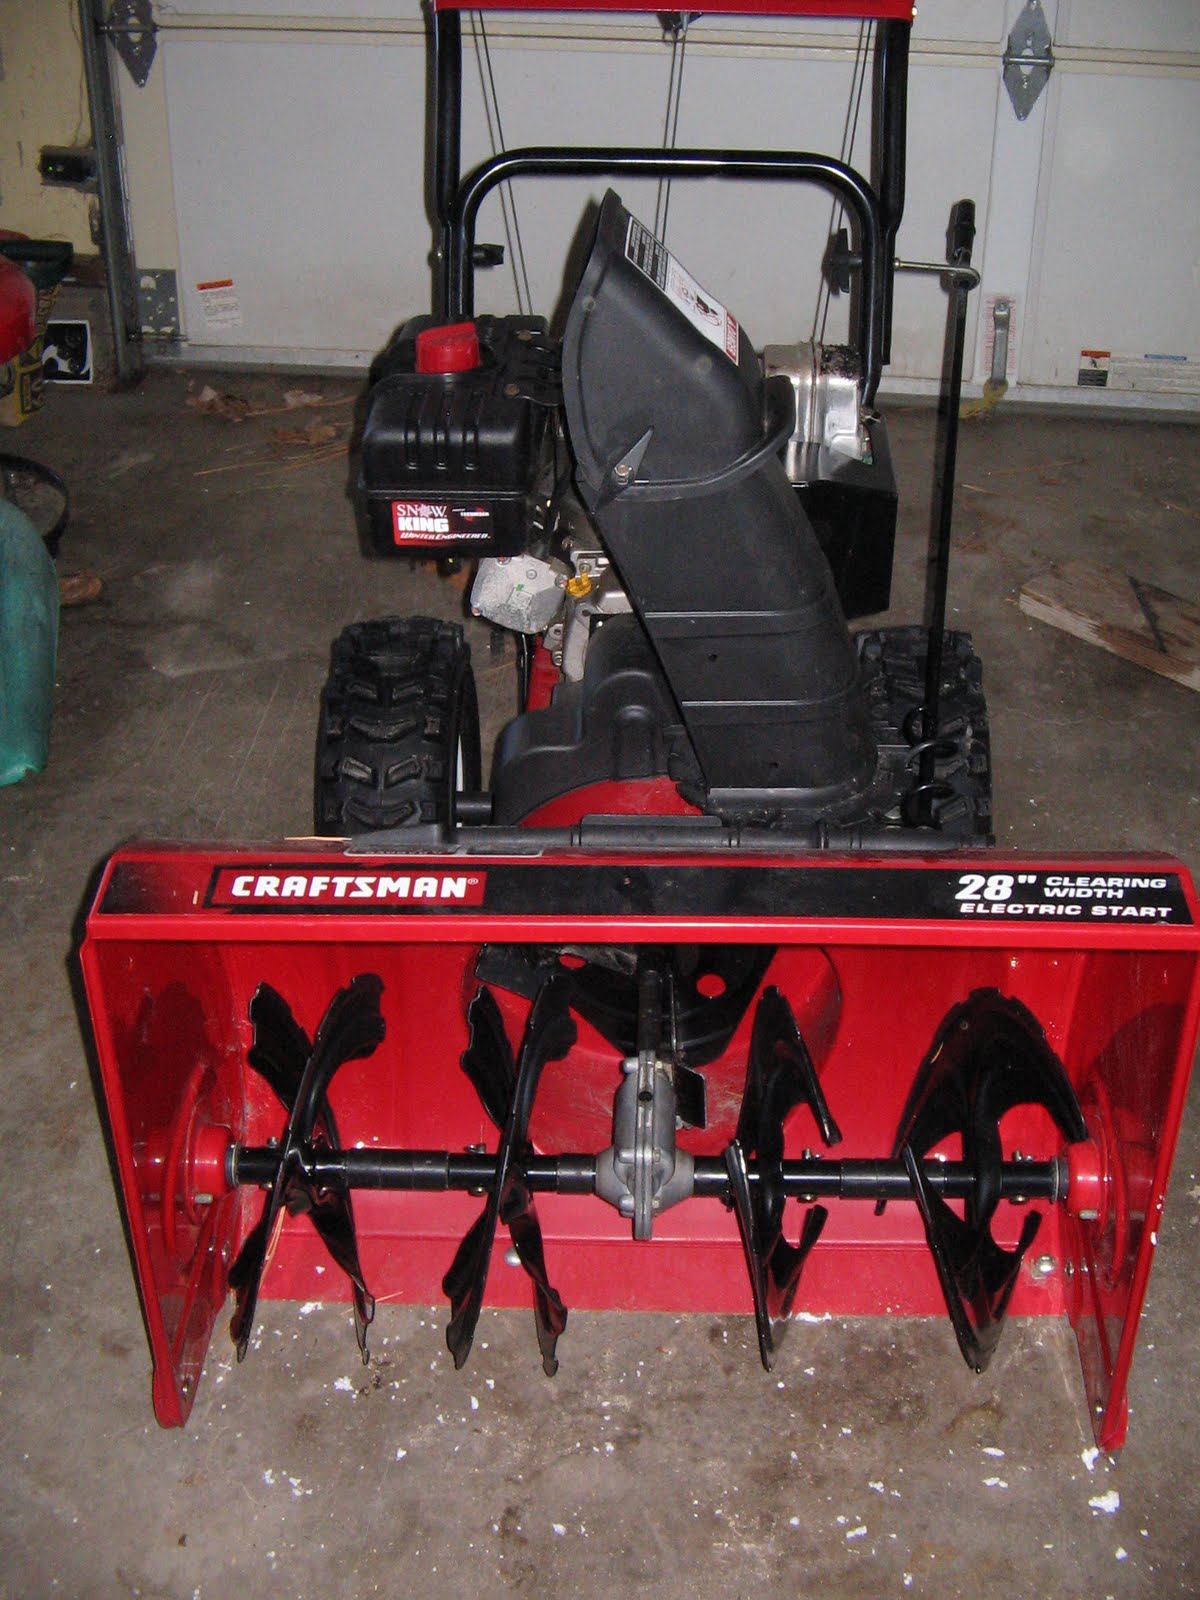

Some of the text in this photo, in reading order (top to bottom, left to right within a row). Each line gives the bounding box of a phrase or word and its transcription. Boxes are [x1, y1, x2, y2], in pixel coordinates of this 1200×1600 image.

[397, 516, 450, 533] KING
[400, 532, 489, 540] WINTER ENGINEERED
[1045, 876, 1168, 889] CLEARING
[1043, 887, 1125, 899] WIDTH
[959, 902, 1173, 918] ELECTRIC START
